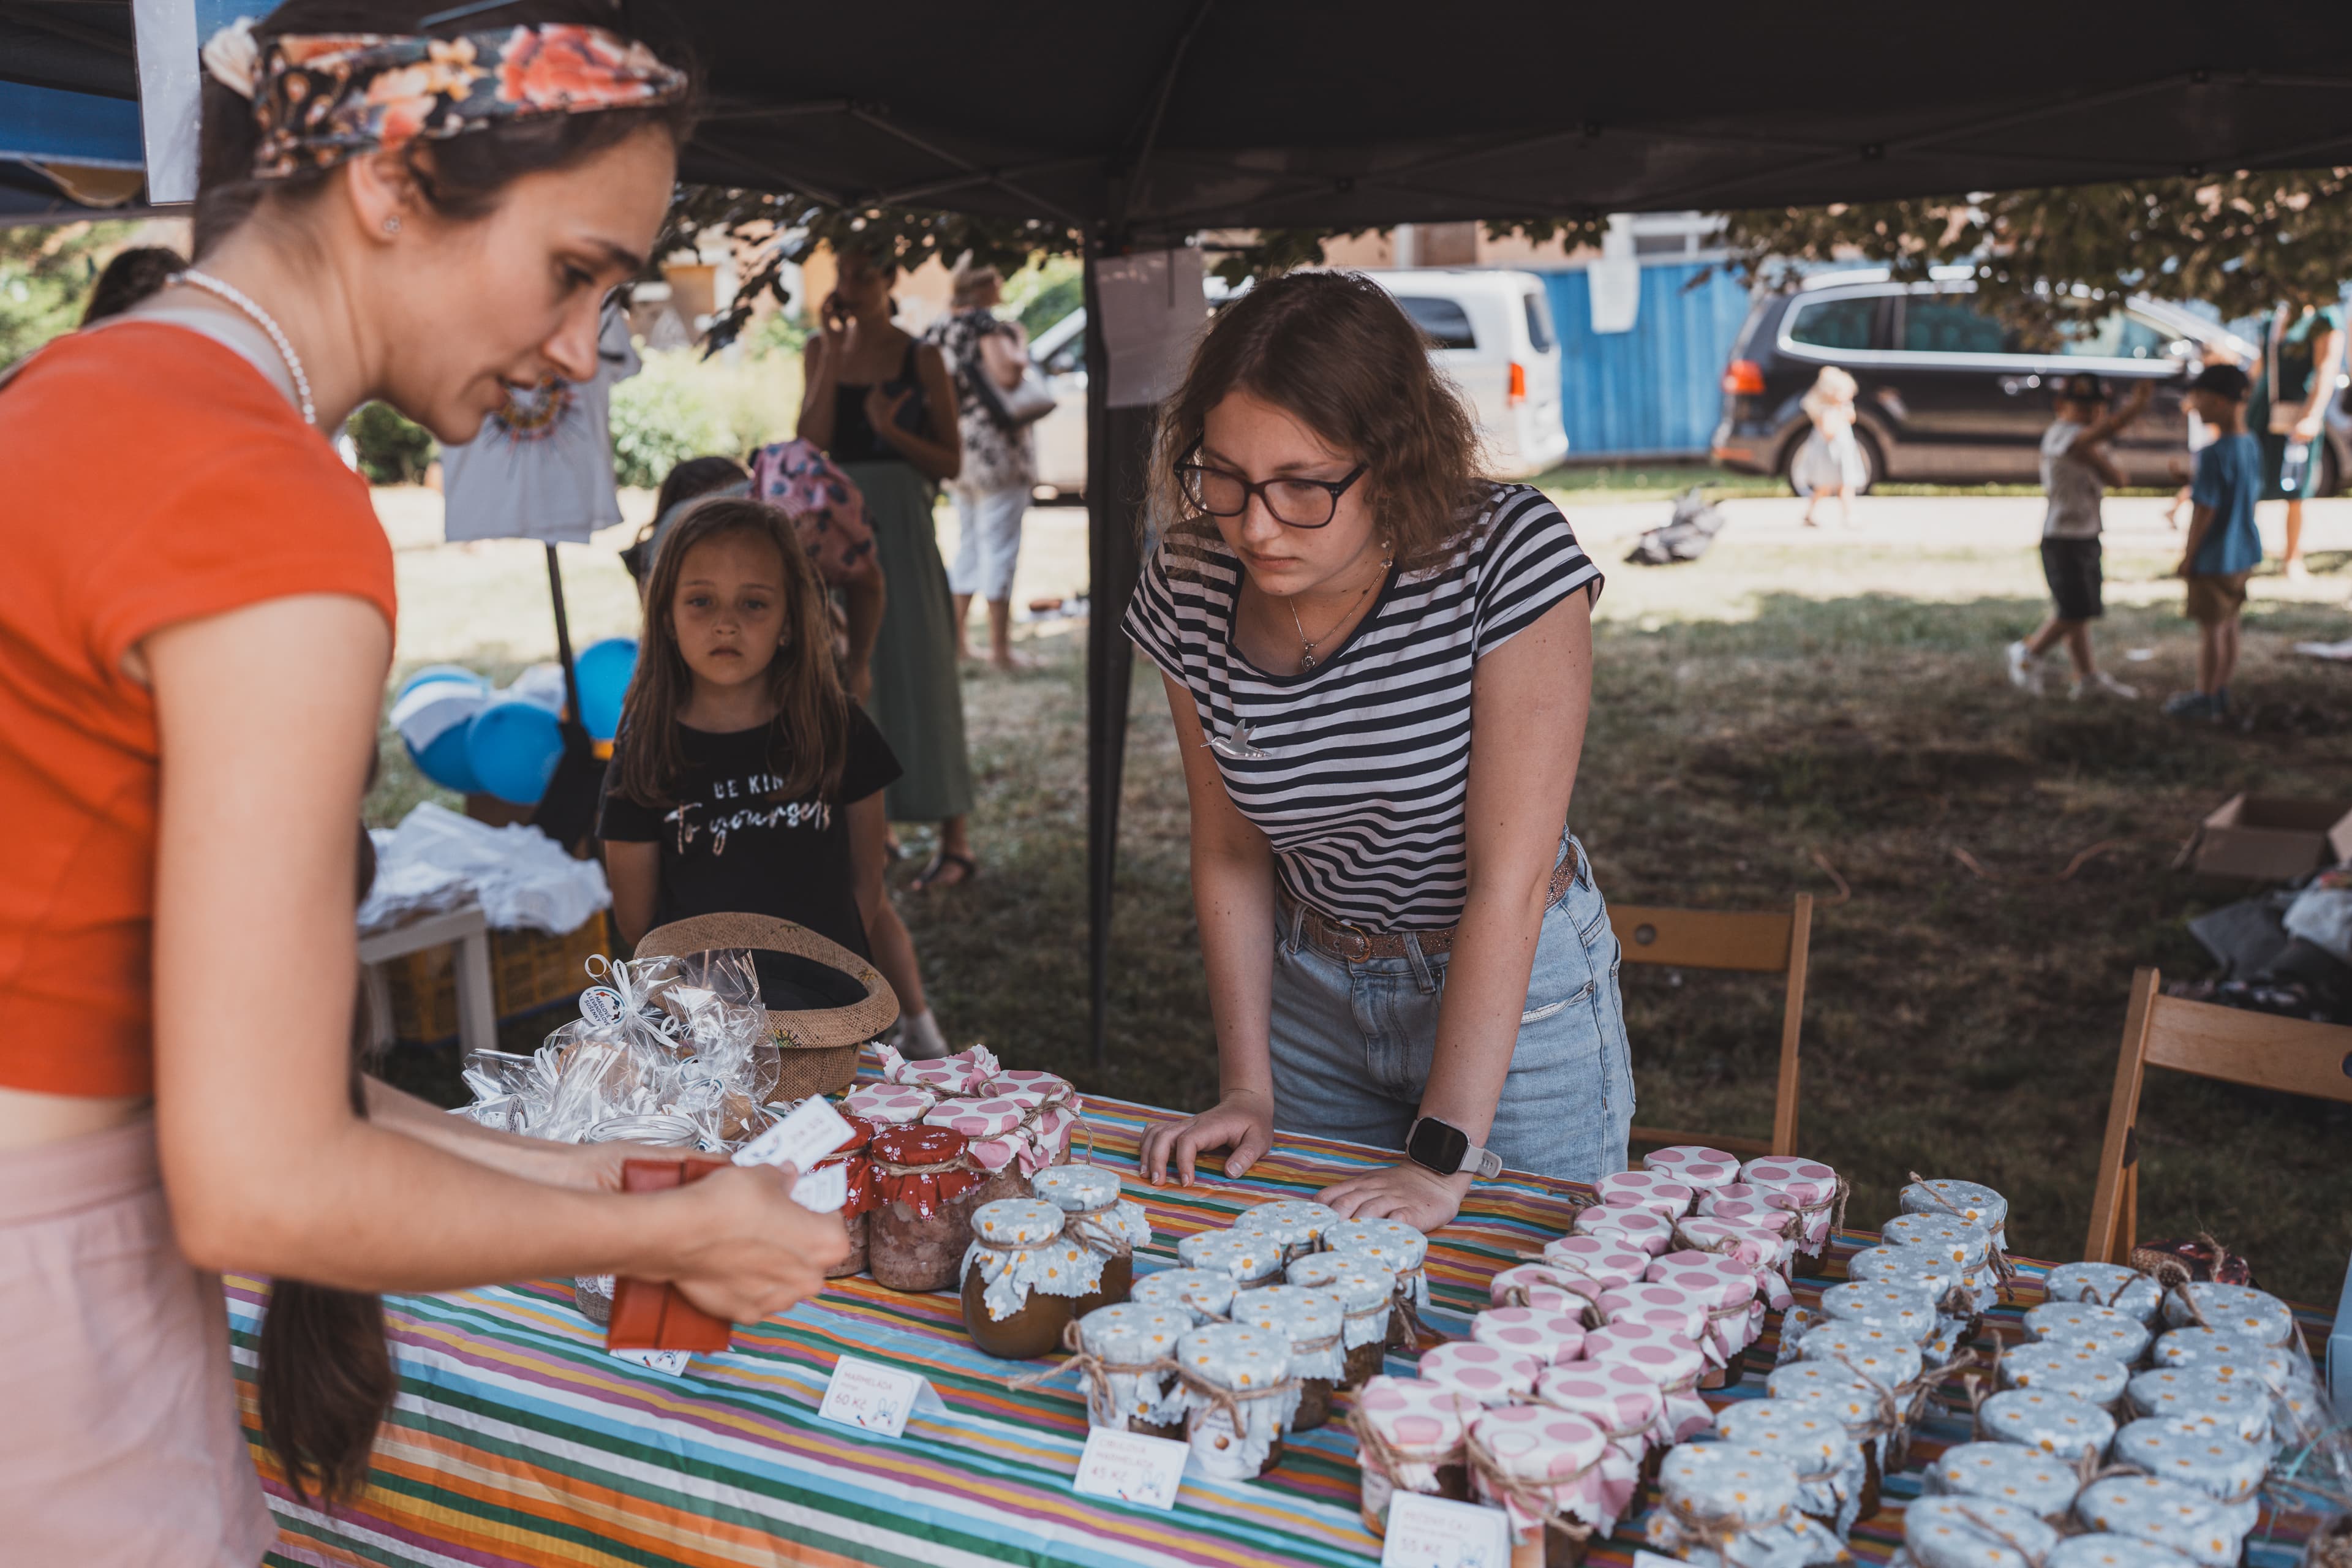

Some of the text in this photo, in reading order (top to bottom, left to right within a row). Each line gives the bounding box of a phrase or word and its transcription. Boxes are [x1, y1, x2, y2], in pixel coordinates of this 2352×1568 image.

[714, 774, 785, 799] BE KIN
[664, 800, 832, 856] To yourself
[584, 1000, 601, 1022] SUŠENKY
[588, 996, 611, 1026] LEVANDULOVÉ
[594, 996, 612, 1019] MÁSLOVÉ
[834, 1392, 850, 1406] 60
